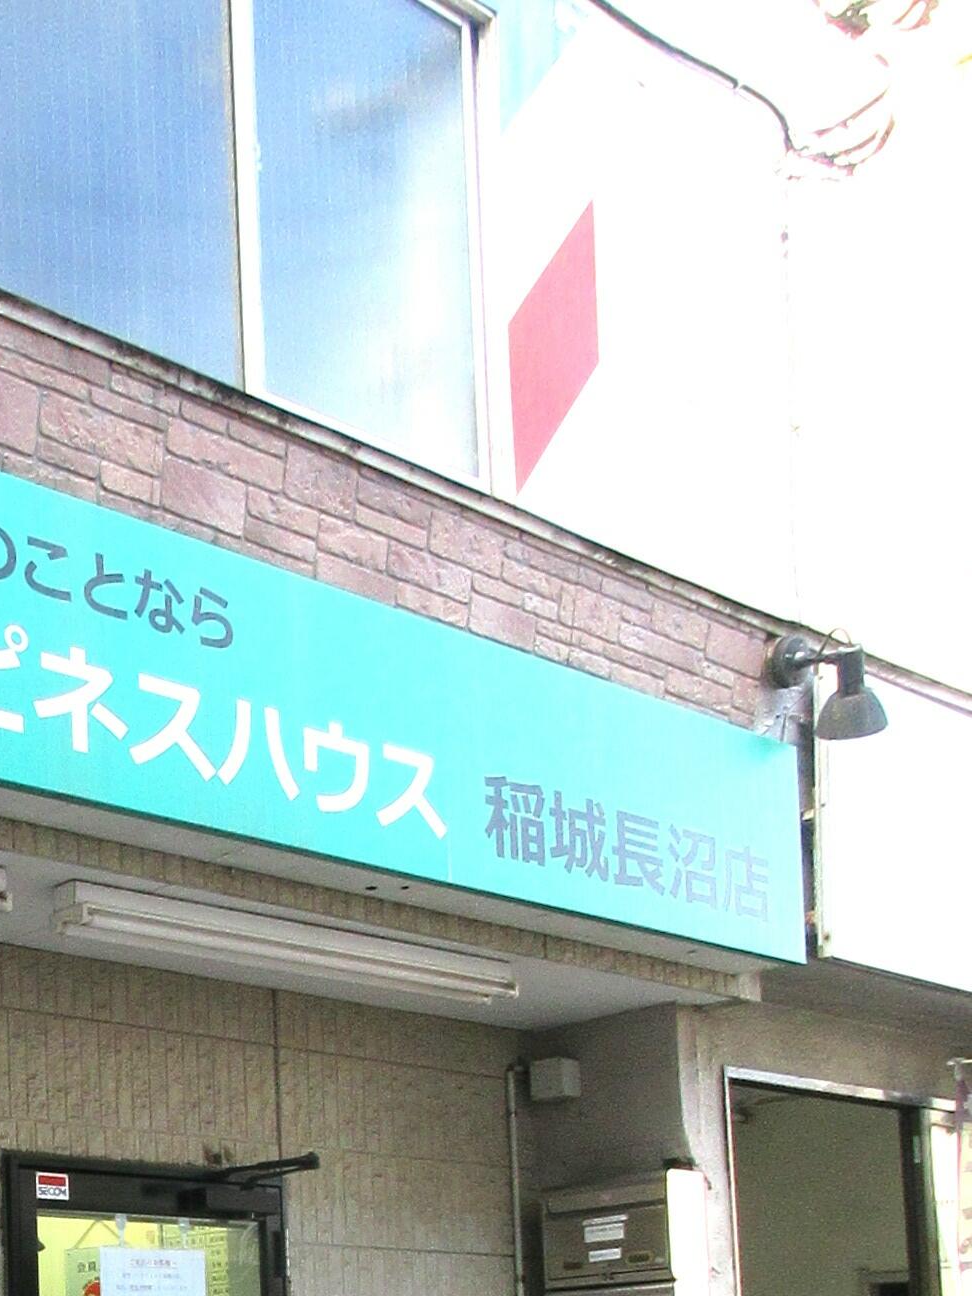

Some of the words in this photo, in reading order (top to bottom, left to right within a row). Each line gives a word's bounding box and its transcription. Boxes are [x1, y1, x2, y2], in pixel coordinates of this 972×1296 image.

[483, 775, 771, 923] 稲城長沼店
